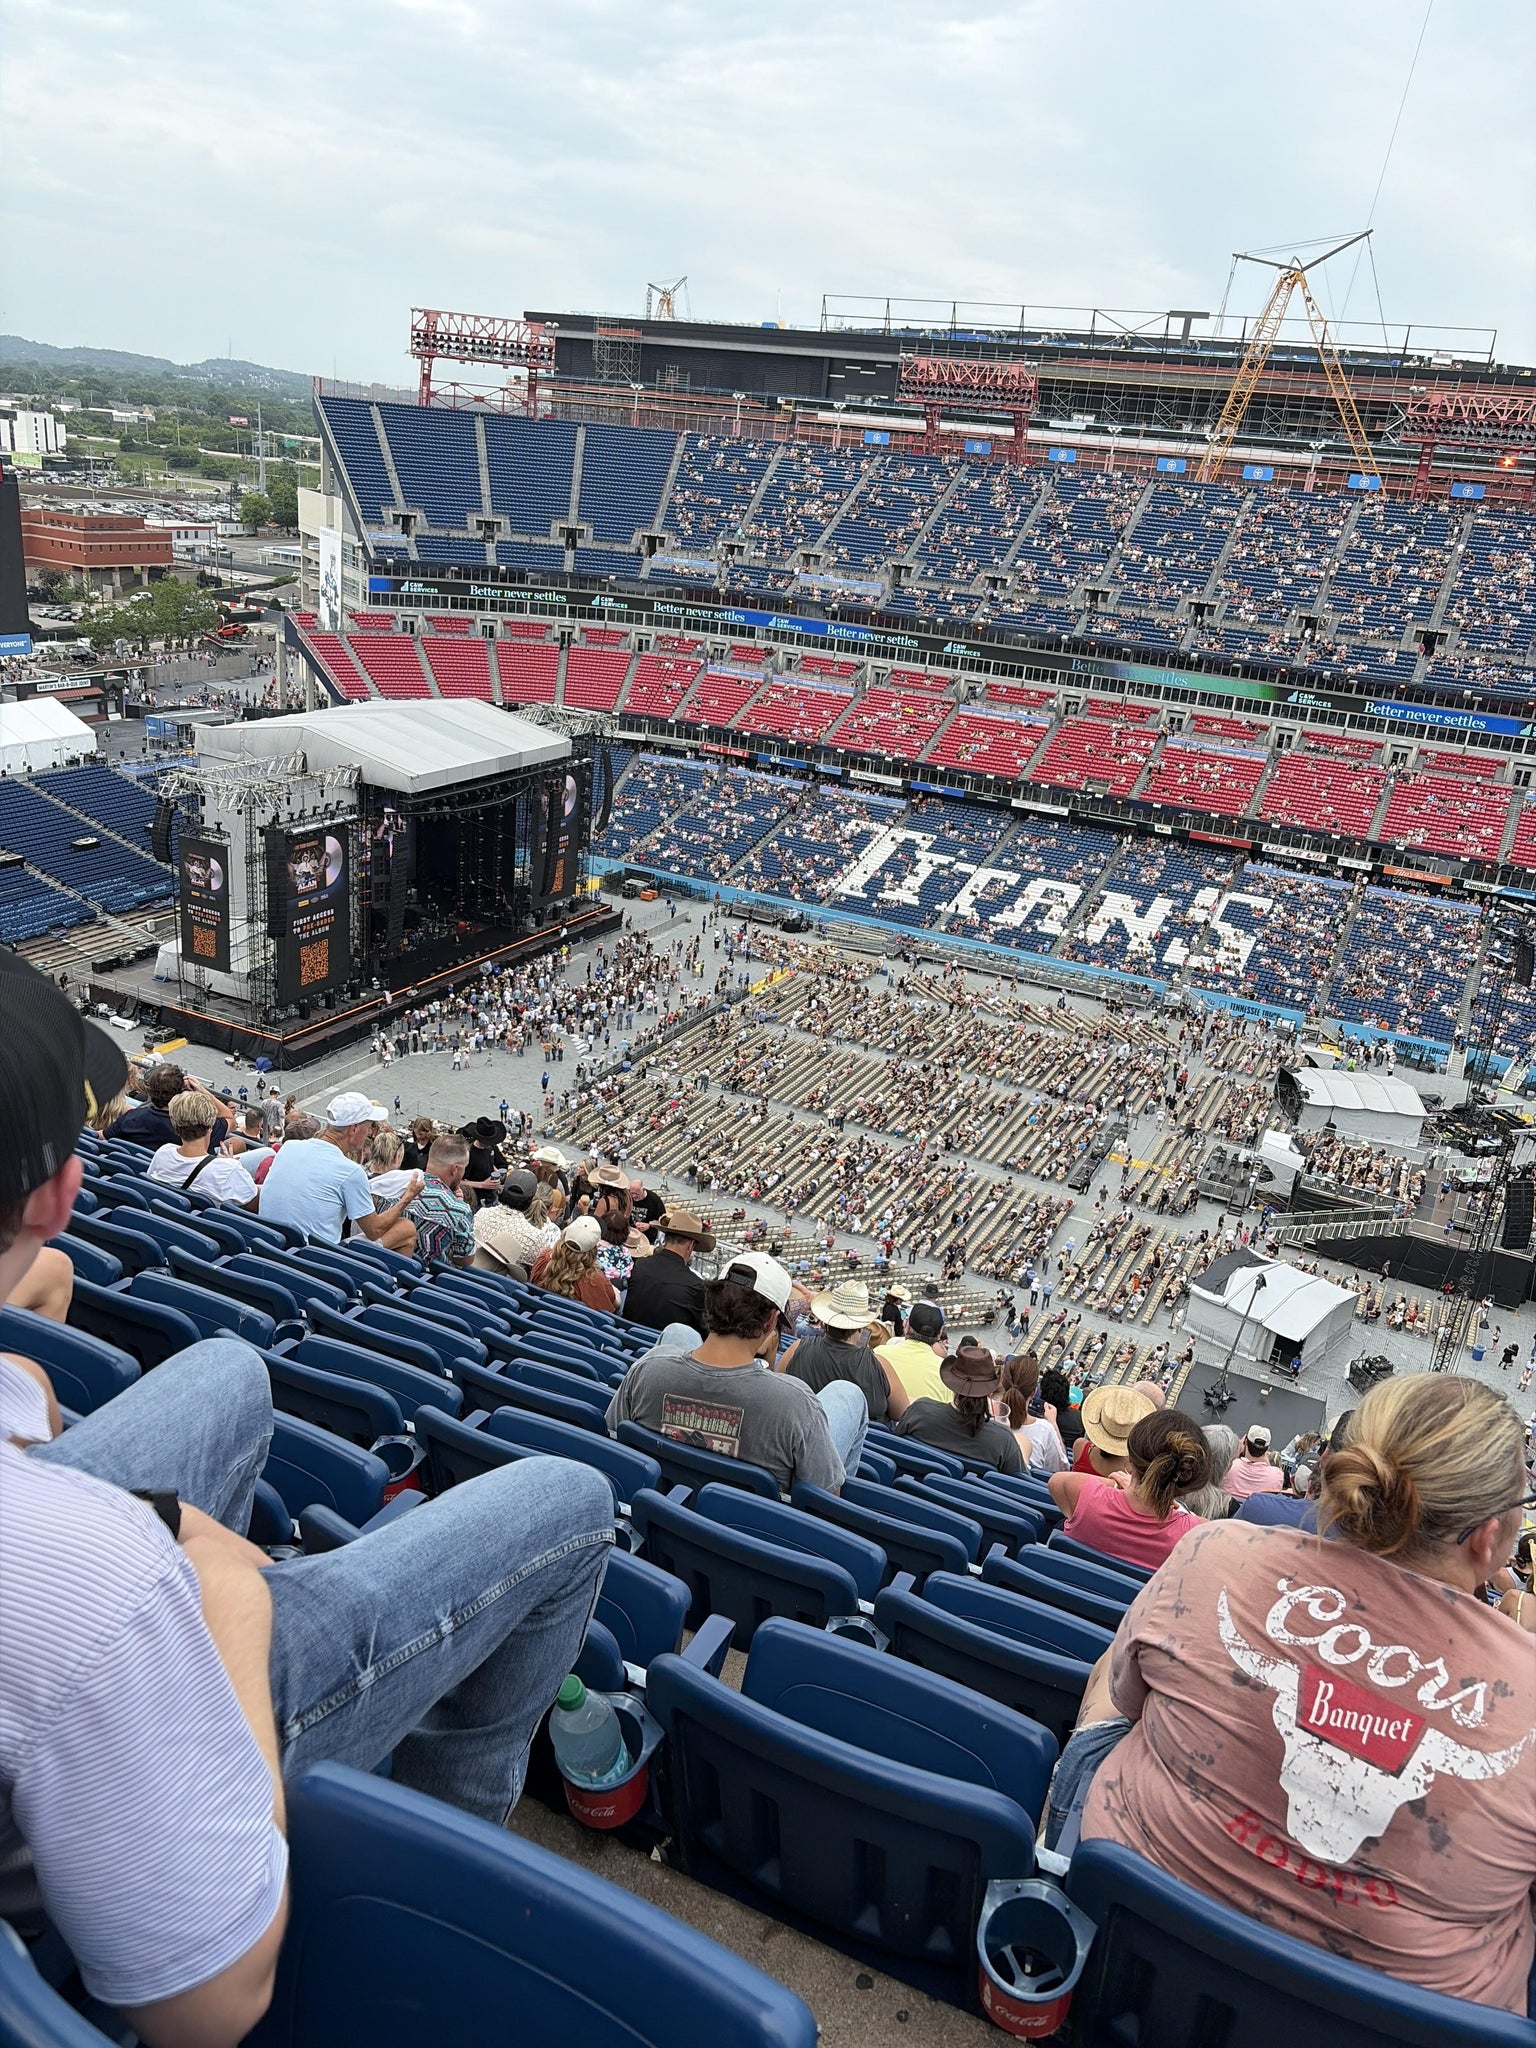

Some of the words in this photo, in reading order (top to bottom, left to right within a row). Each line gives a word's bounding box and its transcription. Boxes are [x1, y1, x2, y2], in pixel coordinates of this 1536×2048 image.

[470, 585, 501, 597] Better
[504, 590, 533, 601] never
[534, 591, 567, 603] settles
[600, 601, 628, 609] SERVICES
[653, 601, 685, 615] Better
[686, 608, 713, 619] never
[713, 609, 745, 623] settles
[777, 622, 802, 631] SERVICES
[827, 624, 857, 638] Better
[858, 632, 885, 643] never
[886, 633, 919, 648] settles
[952, 648, 981, 657] SERVICES
[1071, 659, 1105, 675] Bette
[57, 681, 78, 689] BAR-B-QUE
[1298, 692, 1315, 700] C&W
[1298, 698, 1332, 708] SERVICES
[1363, 700, 1405, 718] Better
[1403, 710, 1443, 723] never
[1443, 711, 1487, 730] settles
[1208, 836, 1232, 844] NISSAN
[1392, 877, 1427, 889] CAMPBELL
[1464, 881, 1494, 892] Pinnacle
[1440, 886, 1469, 897] PHILLIPS
[187, 903, 202, 911] FIRST
[202, 906, 221, 916] ACCESS
[293, 916, 311, 927] FIRST
[312, 908, 335, 921] ACCESS
[292, 927, 301, 935] TO
[303, 916, 335, 931] PRE-ORDER
[299, 931, 310, 940] THE
[311, 925, 330, 936] ALBUM
[1229, 1002, 1261, 1018] TENNESSEE
[1394, 1038, 1428, 1052] TENNESSEE
[1265, 1577, 1488, 1729] Coors
[1308, 1680, 1415, 1745] Banquet
[1225, 1807, 1400, 1908] RODEO
